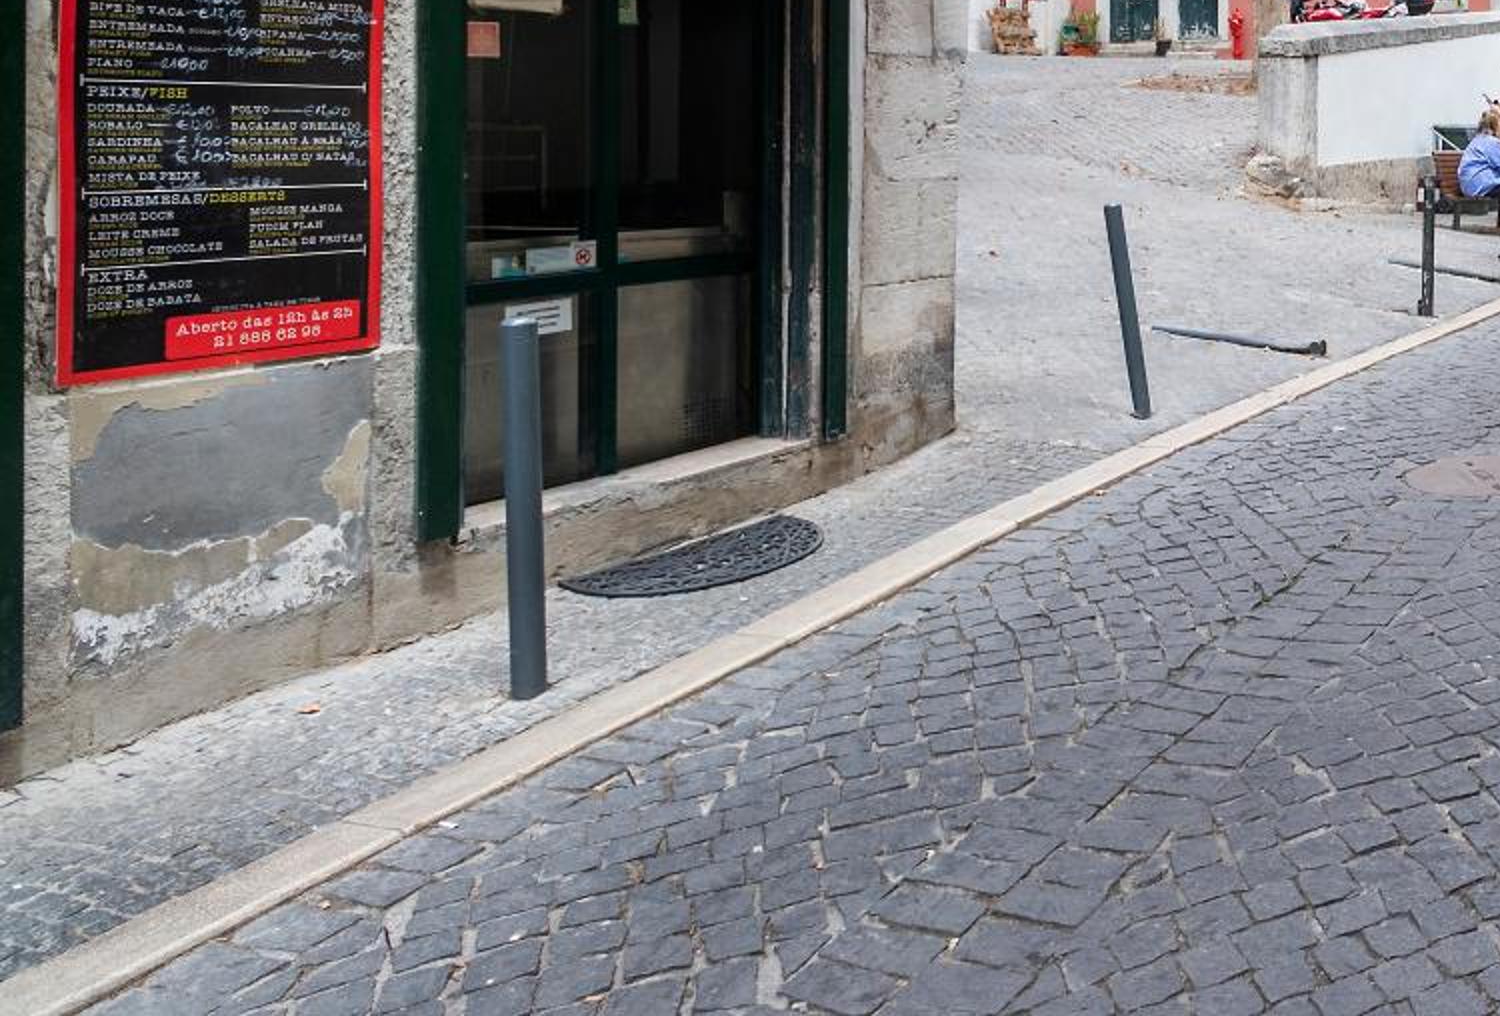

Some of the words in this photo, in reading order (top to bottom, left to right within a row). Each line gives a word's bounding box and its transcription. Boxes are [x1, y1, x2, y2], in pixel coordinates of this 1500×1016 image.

[86, 85, 188, 100] PEIXE/FISH
[88, 270, 148, 284] EXTRA
[176, 317, 237, 337] Aberto
[242, 316, 272, 329] das
